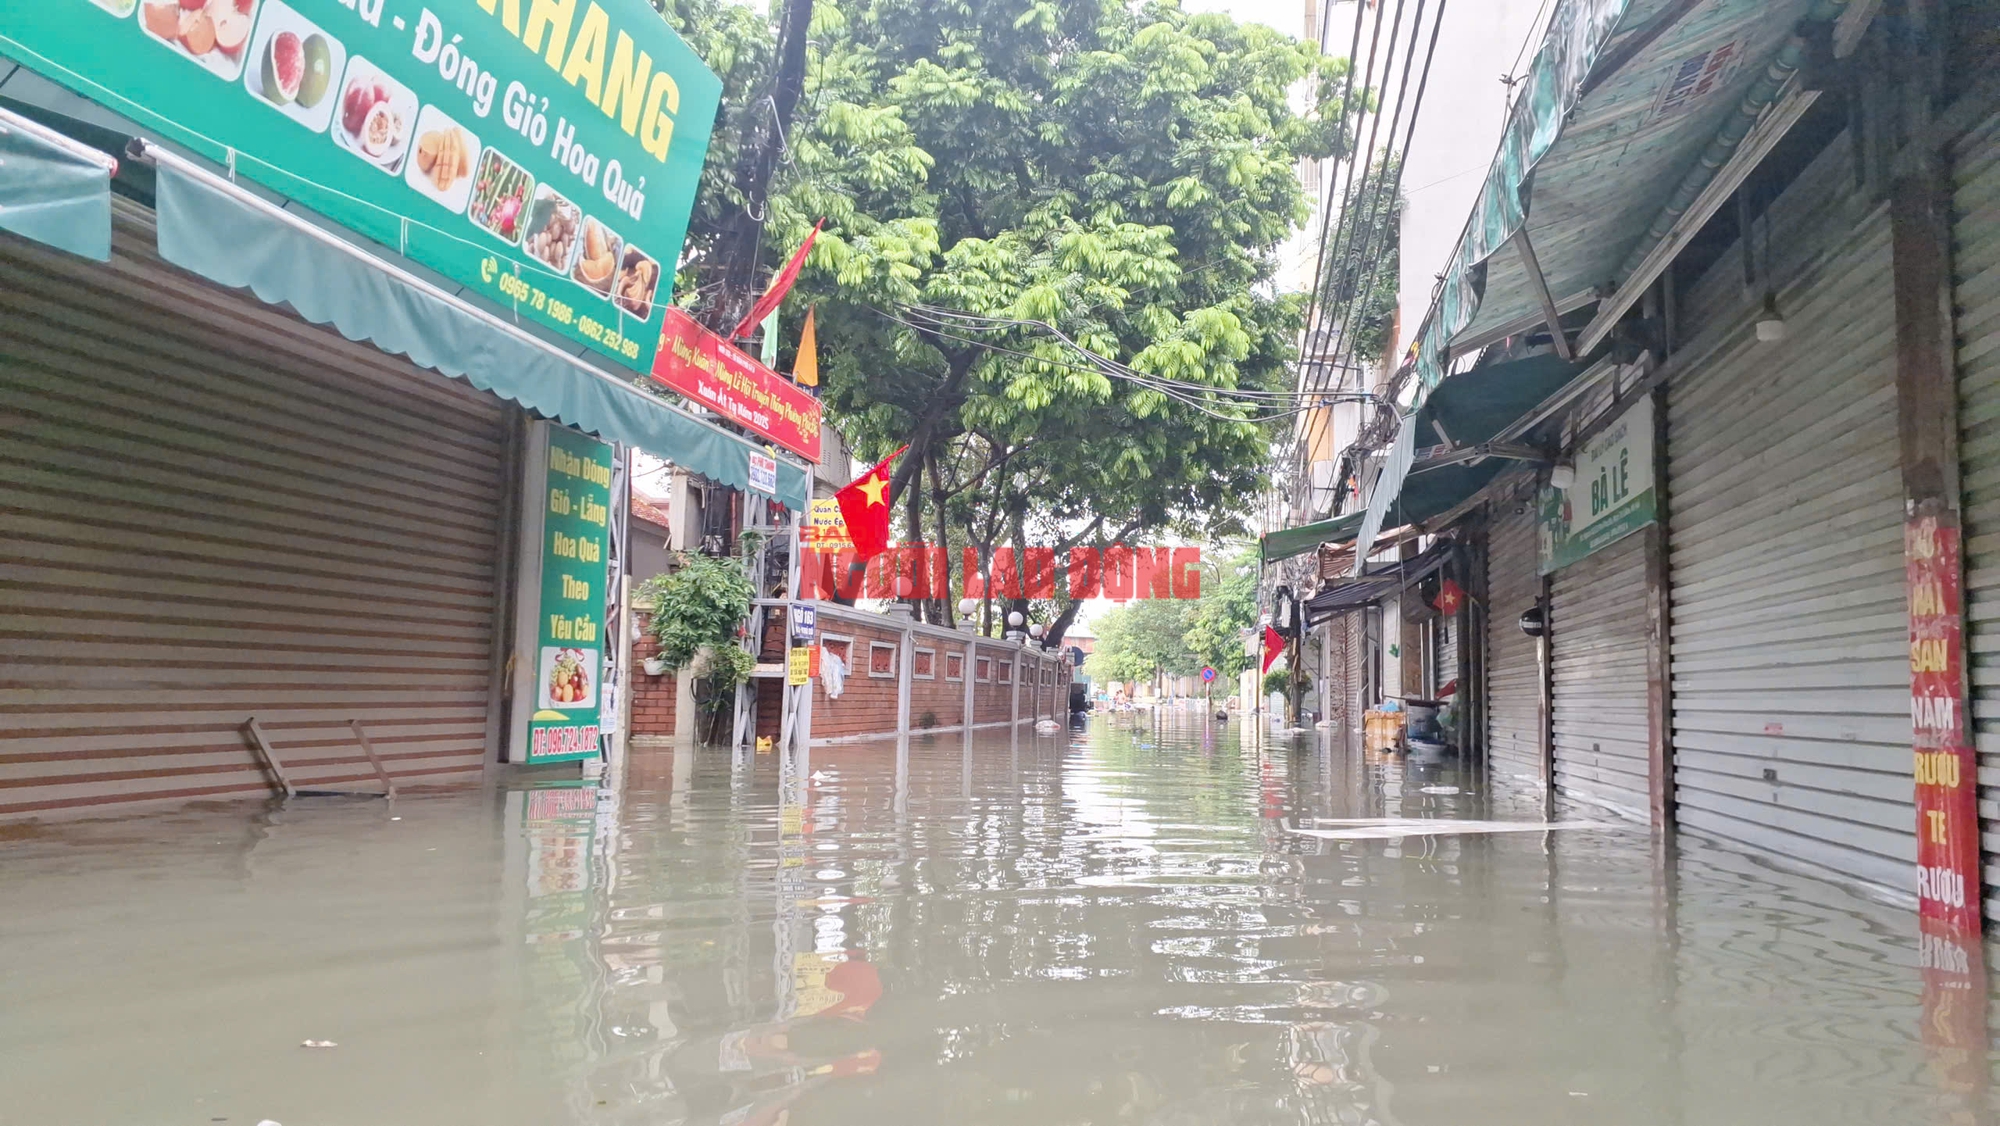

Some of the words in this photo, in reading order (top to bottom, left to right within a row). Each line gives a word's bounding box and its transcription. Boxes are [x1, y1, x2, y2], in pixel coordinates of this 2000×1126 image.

[412, 7, 498, 118] Đóng
[502, 80, 549, 146] Giỏ
[550, 117, 600, 187] Hoa
[602, 159, 645, 221] Quả
[499, 272, 530, 303] 0965
[529, 288, 546, 311] 78
[547, 298, 574, 325] 1986
[602, 328, 623, 351] 252
[753, 410, 769, 430] 2025
[550, 445, 580, 480] Nhận
[583, 456, 610, 489] Đóng
[550, 488, 570, 515] Giỏ
[553, 530, 577, 558] Hoa
[579, 536, 600, 563] Quả
[562, 573, 590, 601] Theo
[550, 613, 572, 640] Yêu
[575, 613, 597, 642] Cầu
